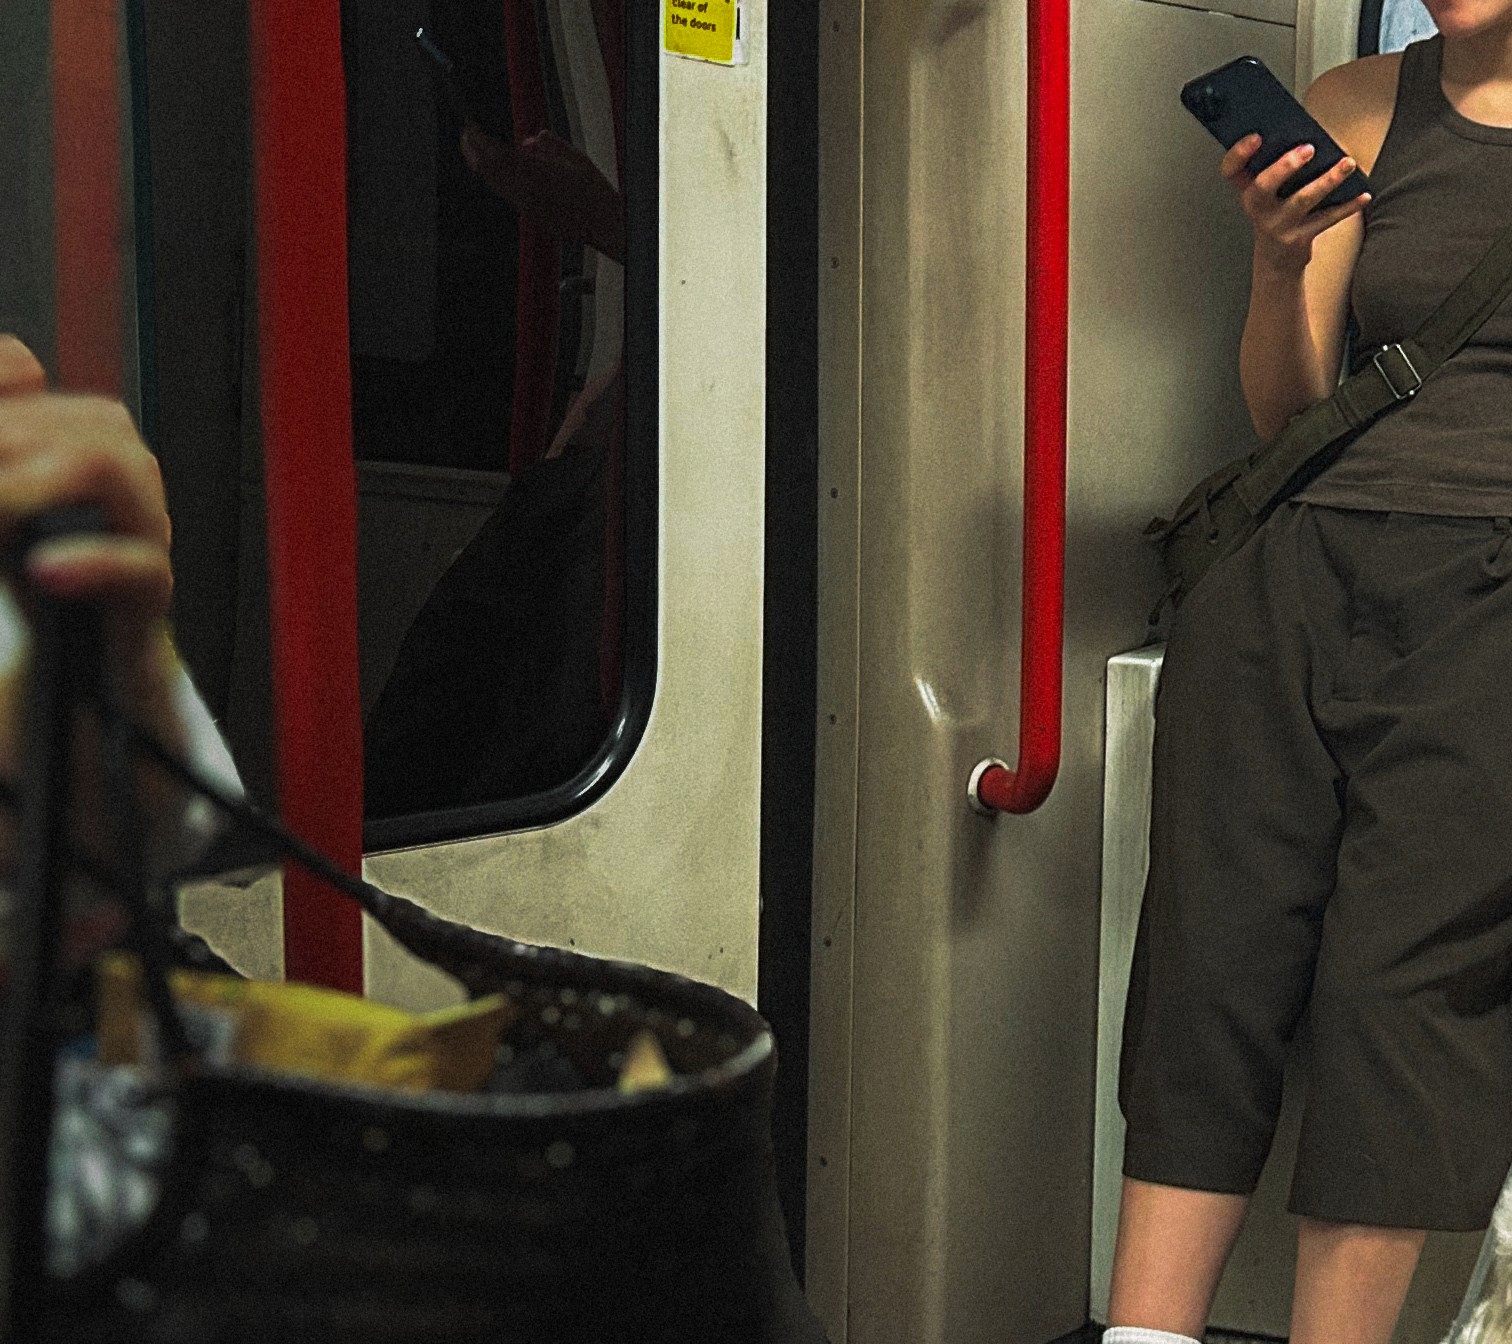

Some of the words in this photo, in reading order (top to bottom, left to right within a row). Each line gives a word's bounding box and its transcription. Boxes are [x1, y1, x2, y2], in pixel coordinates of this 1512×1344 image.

[697, 2, 708, 13] of
[671, 14, 687, 27] the
[690, 18, 716, 32] doors
